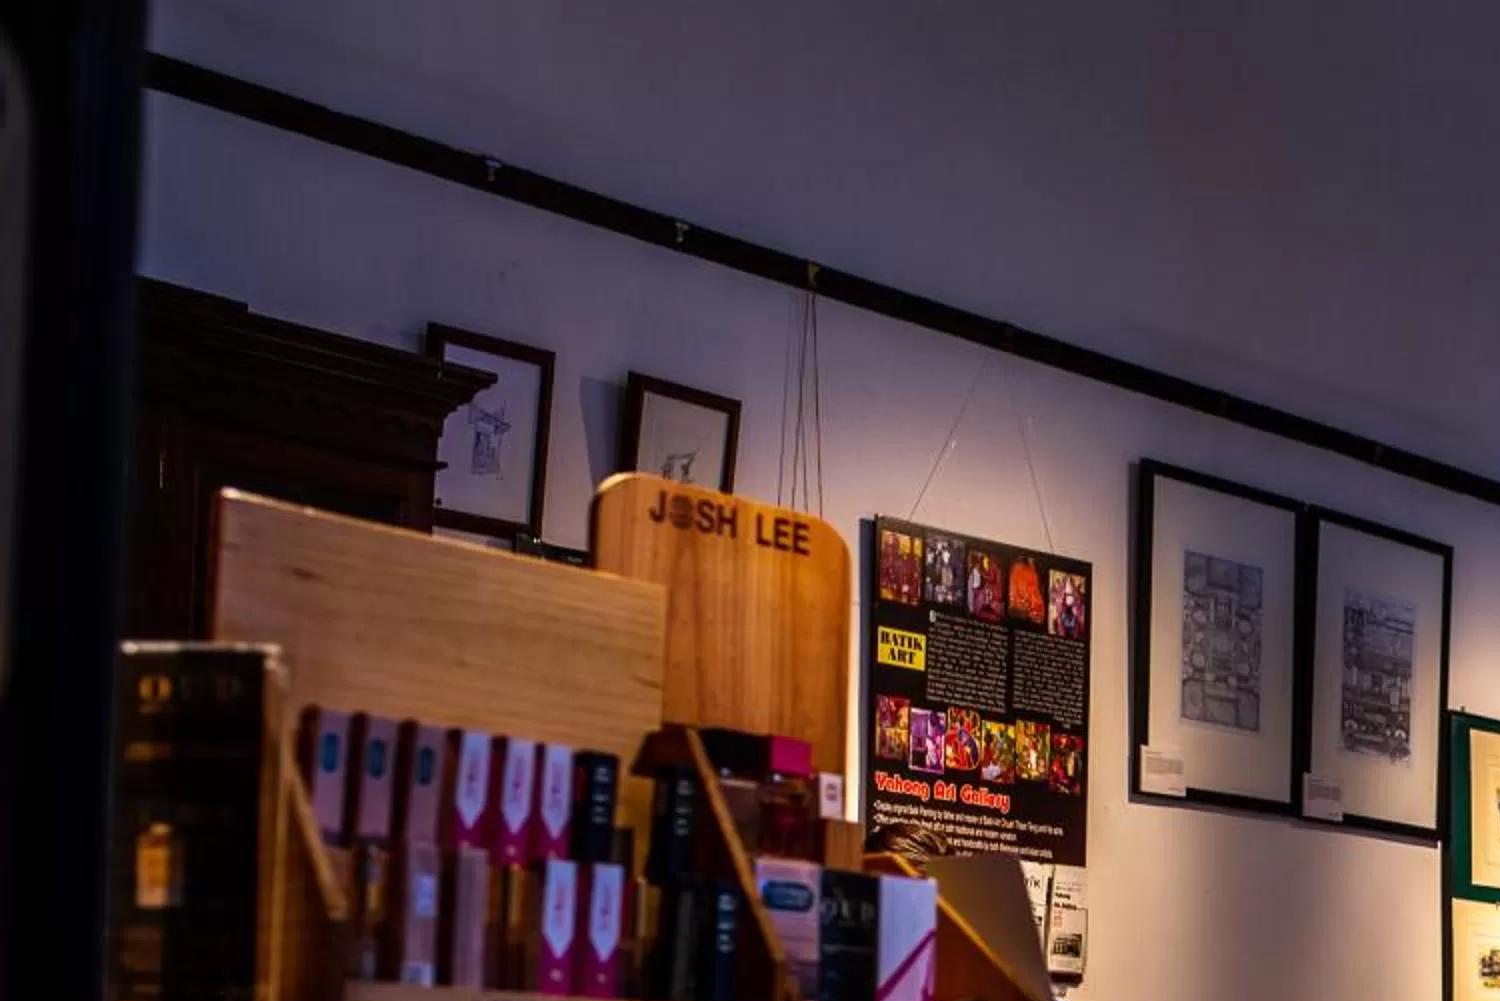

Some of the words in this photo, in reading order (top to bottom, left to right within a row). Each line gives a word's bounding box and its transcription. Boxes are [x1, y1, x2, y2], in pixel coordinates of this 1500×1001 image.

[650, 489, 738, 540] JOSH
[756, 512, 811, 556] LEE
[881, 631, 922, 651] BATIK
[888, 648, 916, 665] ART
[875, 771, 930, 802] Yahong
[960, 783, 1011, 814] Gallery
